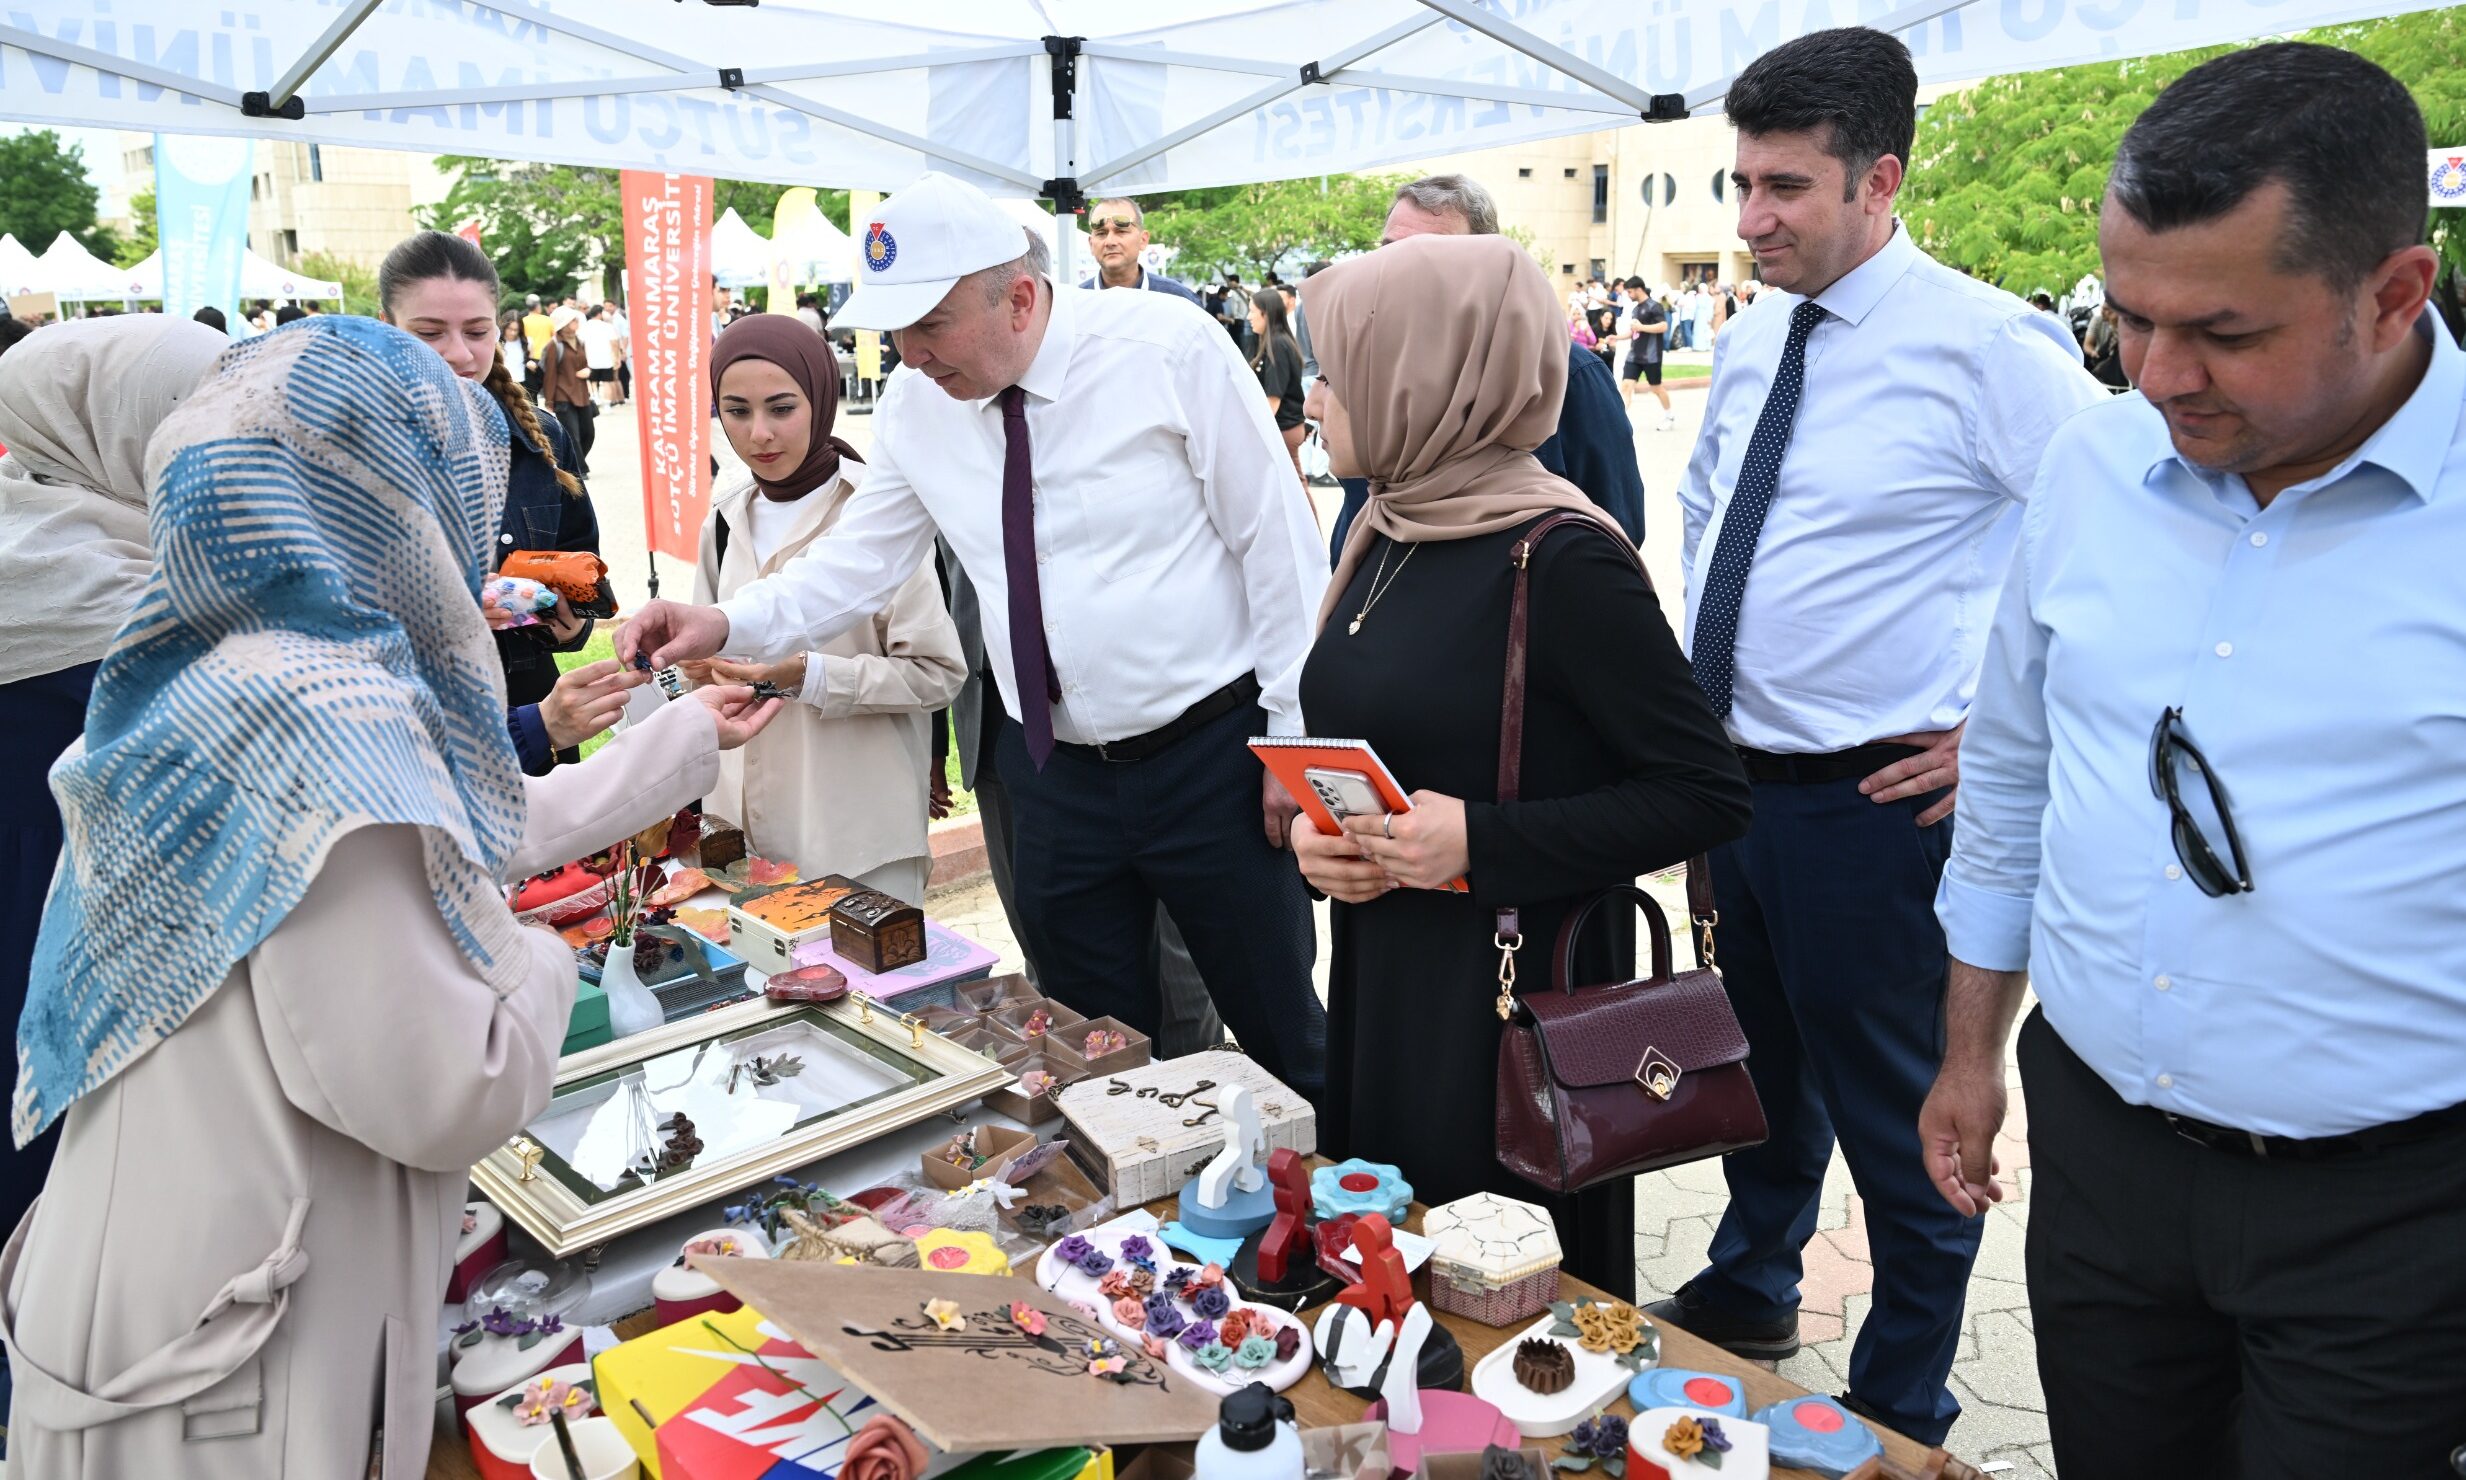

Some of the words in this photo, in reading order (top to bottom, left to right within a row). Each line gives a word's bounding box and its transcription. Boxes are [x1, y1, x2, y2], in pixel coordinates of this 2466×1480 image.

[642, 196, 667, 475] KAHRAMANMARAŞ
[662, 172, 681, 339] ÜNİVERSİT
[662, 349, 678, 434] İMAM
